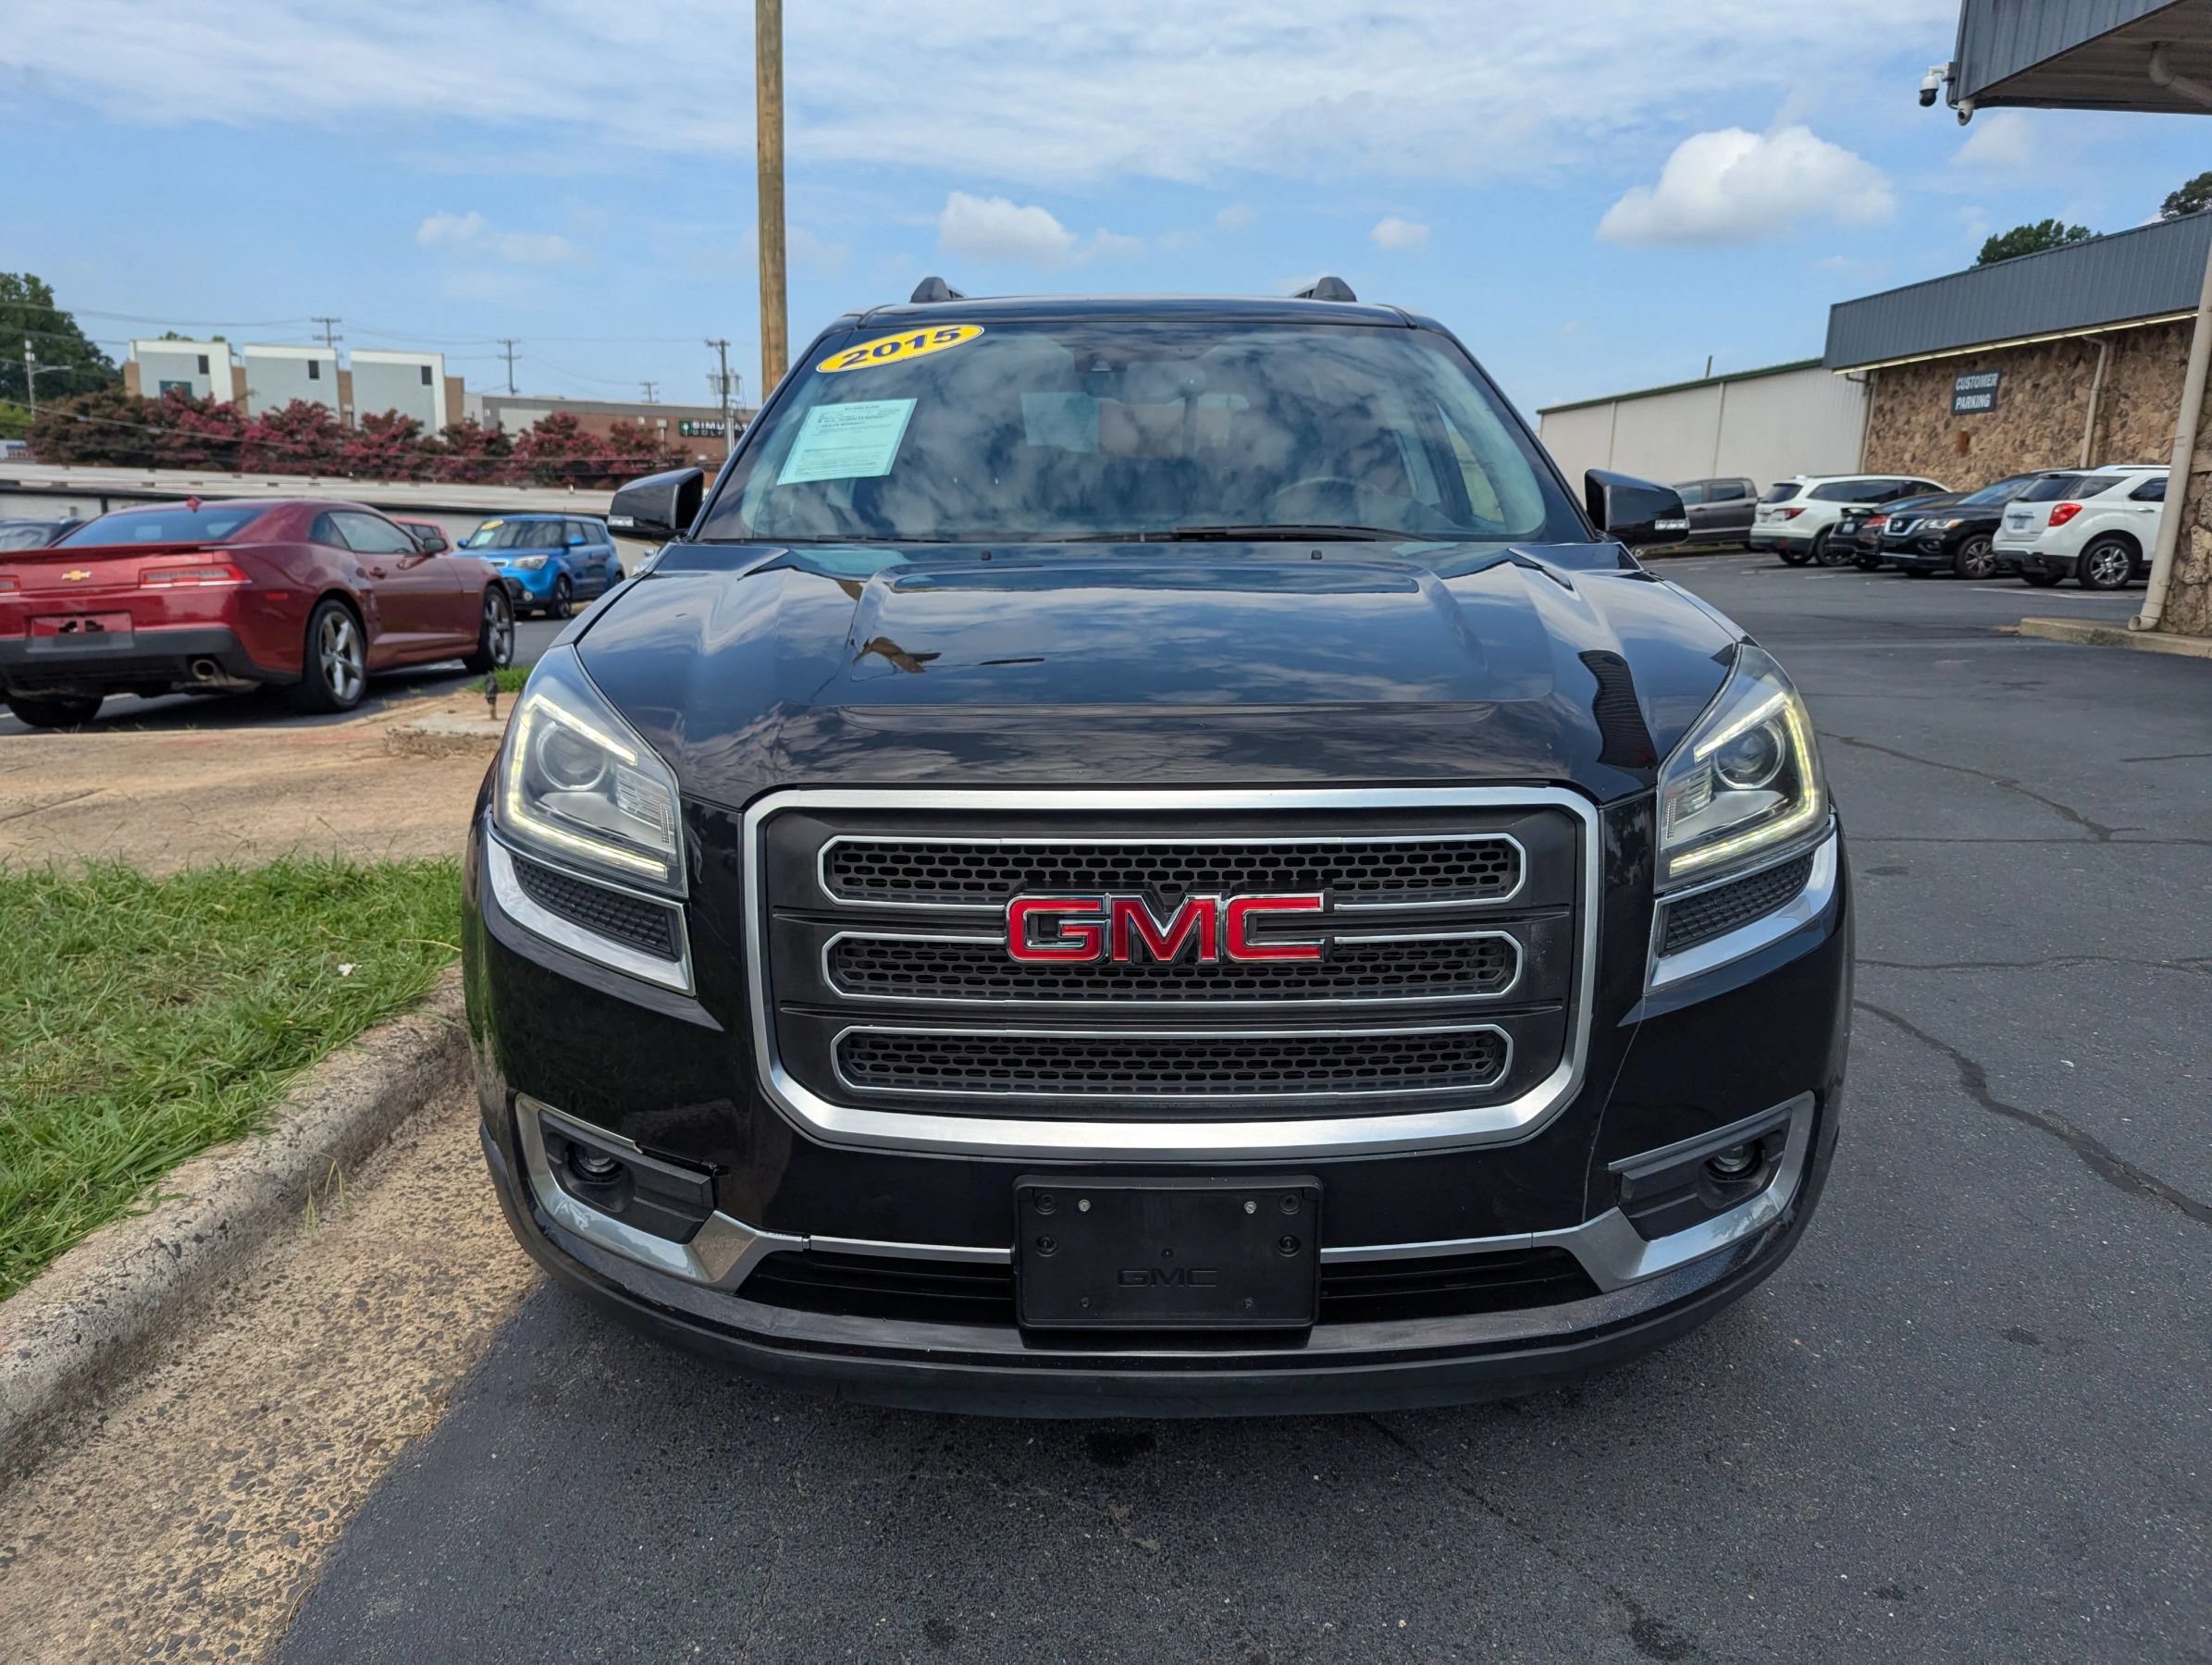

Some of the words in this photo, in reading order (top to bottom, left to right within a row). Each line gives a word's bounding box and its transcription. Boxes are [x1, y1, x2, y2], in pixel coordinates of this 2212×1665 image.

[838, 327, 961, 368] 2015
[1956, 373, 1998, 390] CUSTOMER
[1955, 393, 1991, 410] PARKING
[1006, 893, 1326, 963] GMC
[1118, 1267, 1218, 1288] GMC
